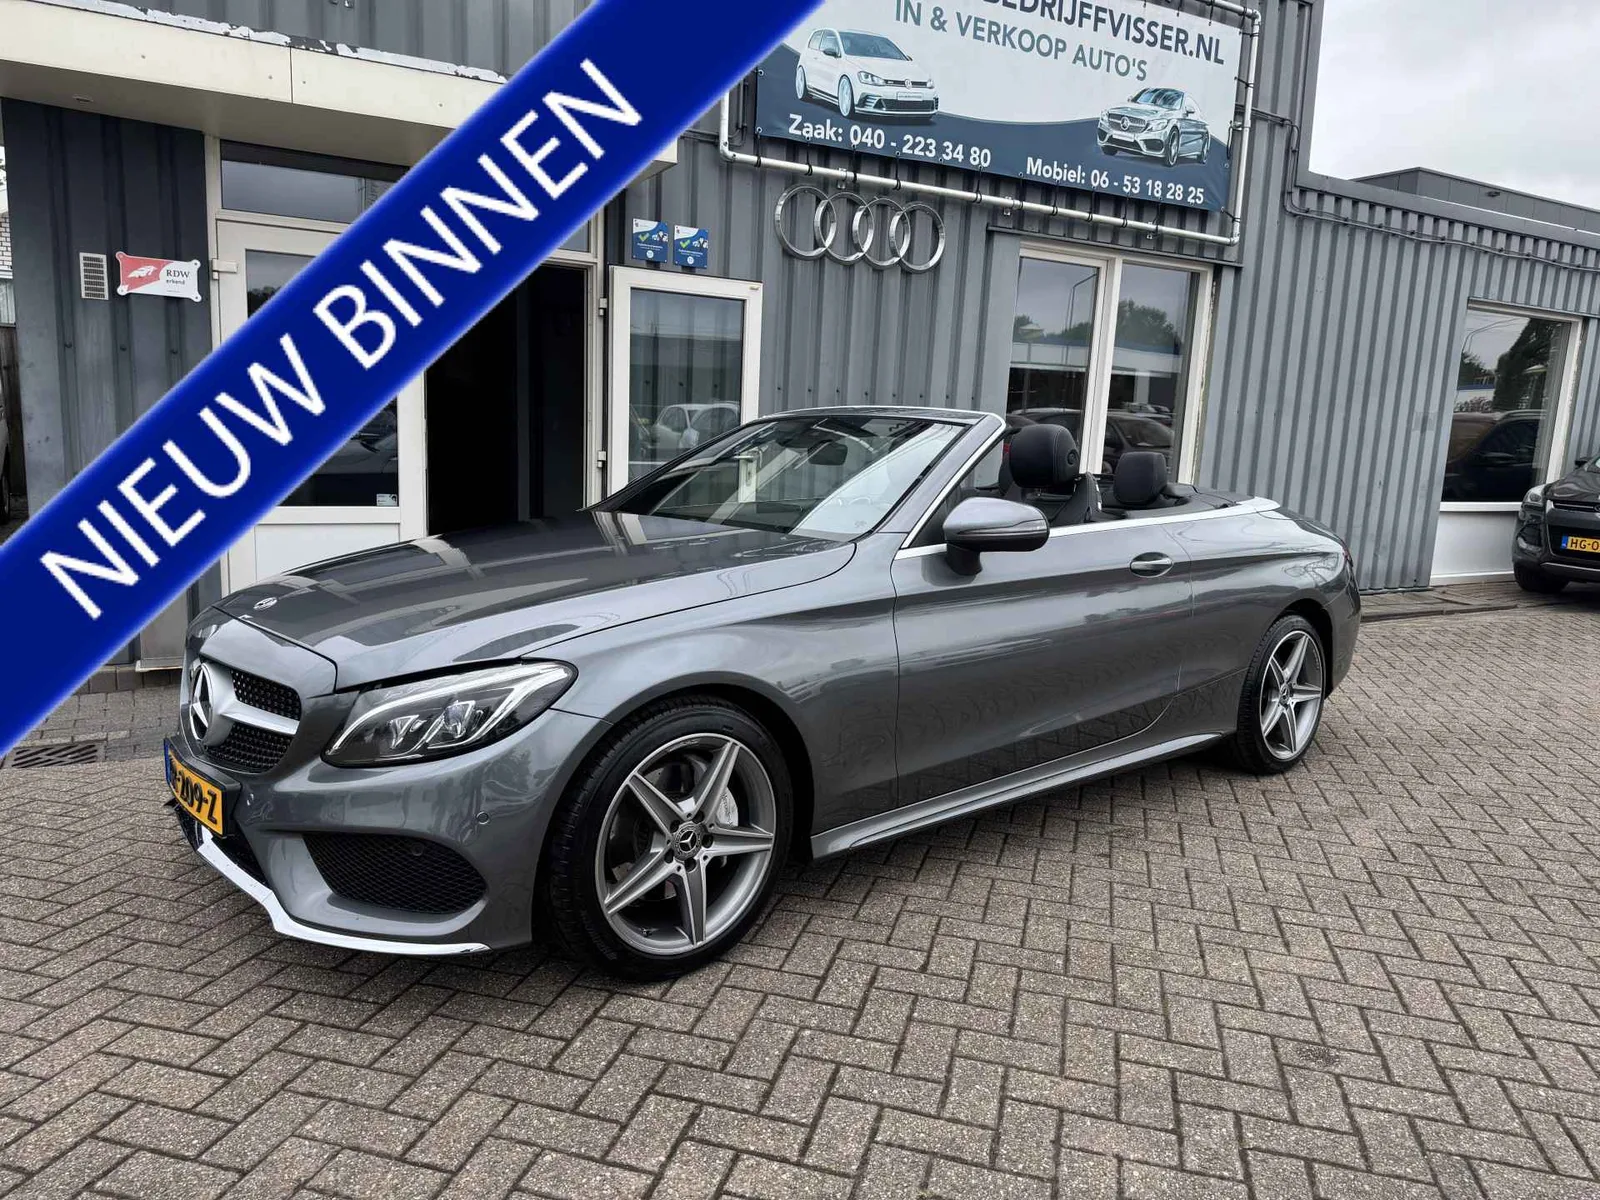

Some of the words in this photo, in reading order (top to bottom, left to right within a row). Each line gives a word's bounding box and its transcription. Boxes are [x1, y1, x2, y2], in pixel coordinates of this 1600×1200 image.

[895, 2, 922, 27] IN
[930, 6, 948, 33] &
[956, 11, 1067, 60] VERKOOP
[1072, 44, 1148, 81] AUTO'S
[983, 0, 1225, 65] DRIJFFVISSER.NL
[788, 113, 843, 142] Zaak:
[849, 124, 885, 149] 040
[902, 134, 936, 158] 223
[942, 141, 964, 163] 34
[969, 146, 991, 168] 80
[1026, 156, 1086, 184] Mobiel:
[1091, 169, 1109, 189] 06
[1122, 175, 1140, 194] 53
[1146, 179, 1162, 197] 18
[1166, 182, 1184, 201] 28
[1187, 186, 1204, 204] 25
[166, 269, 190, 278] RDW
